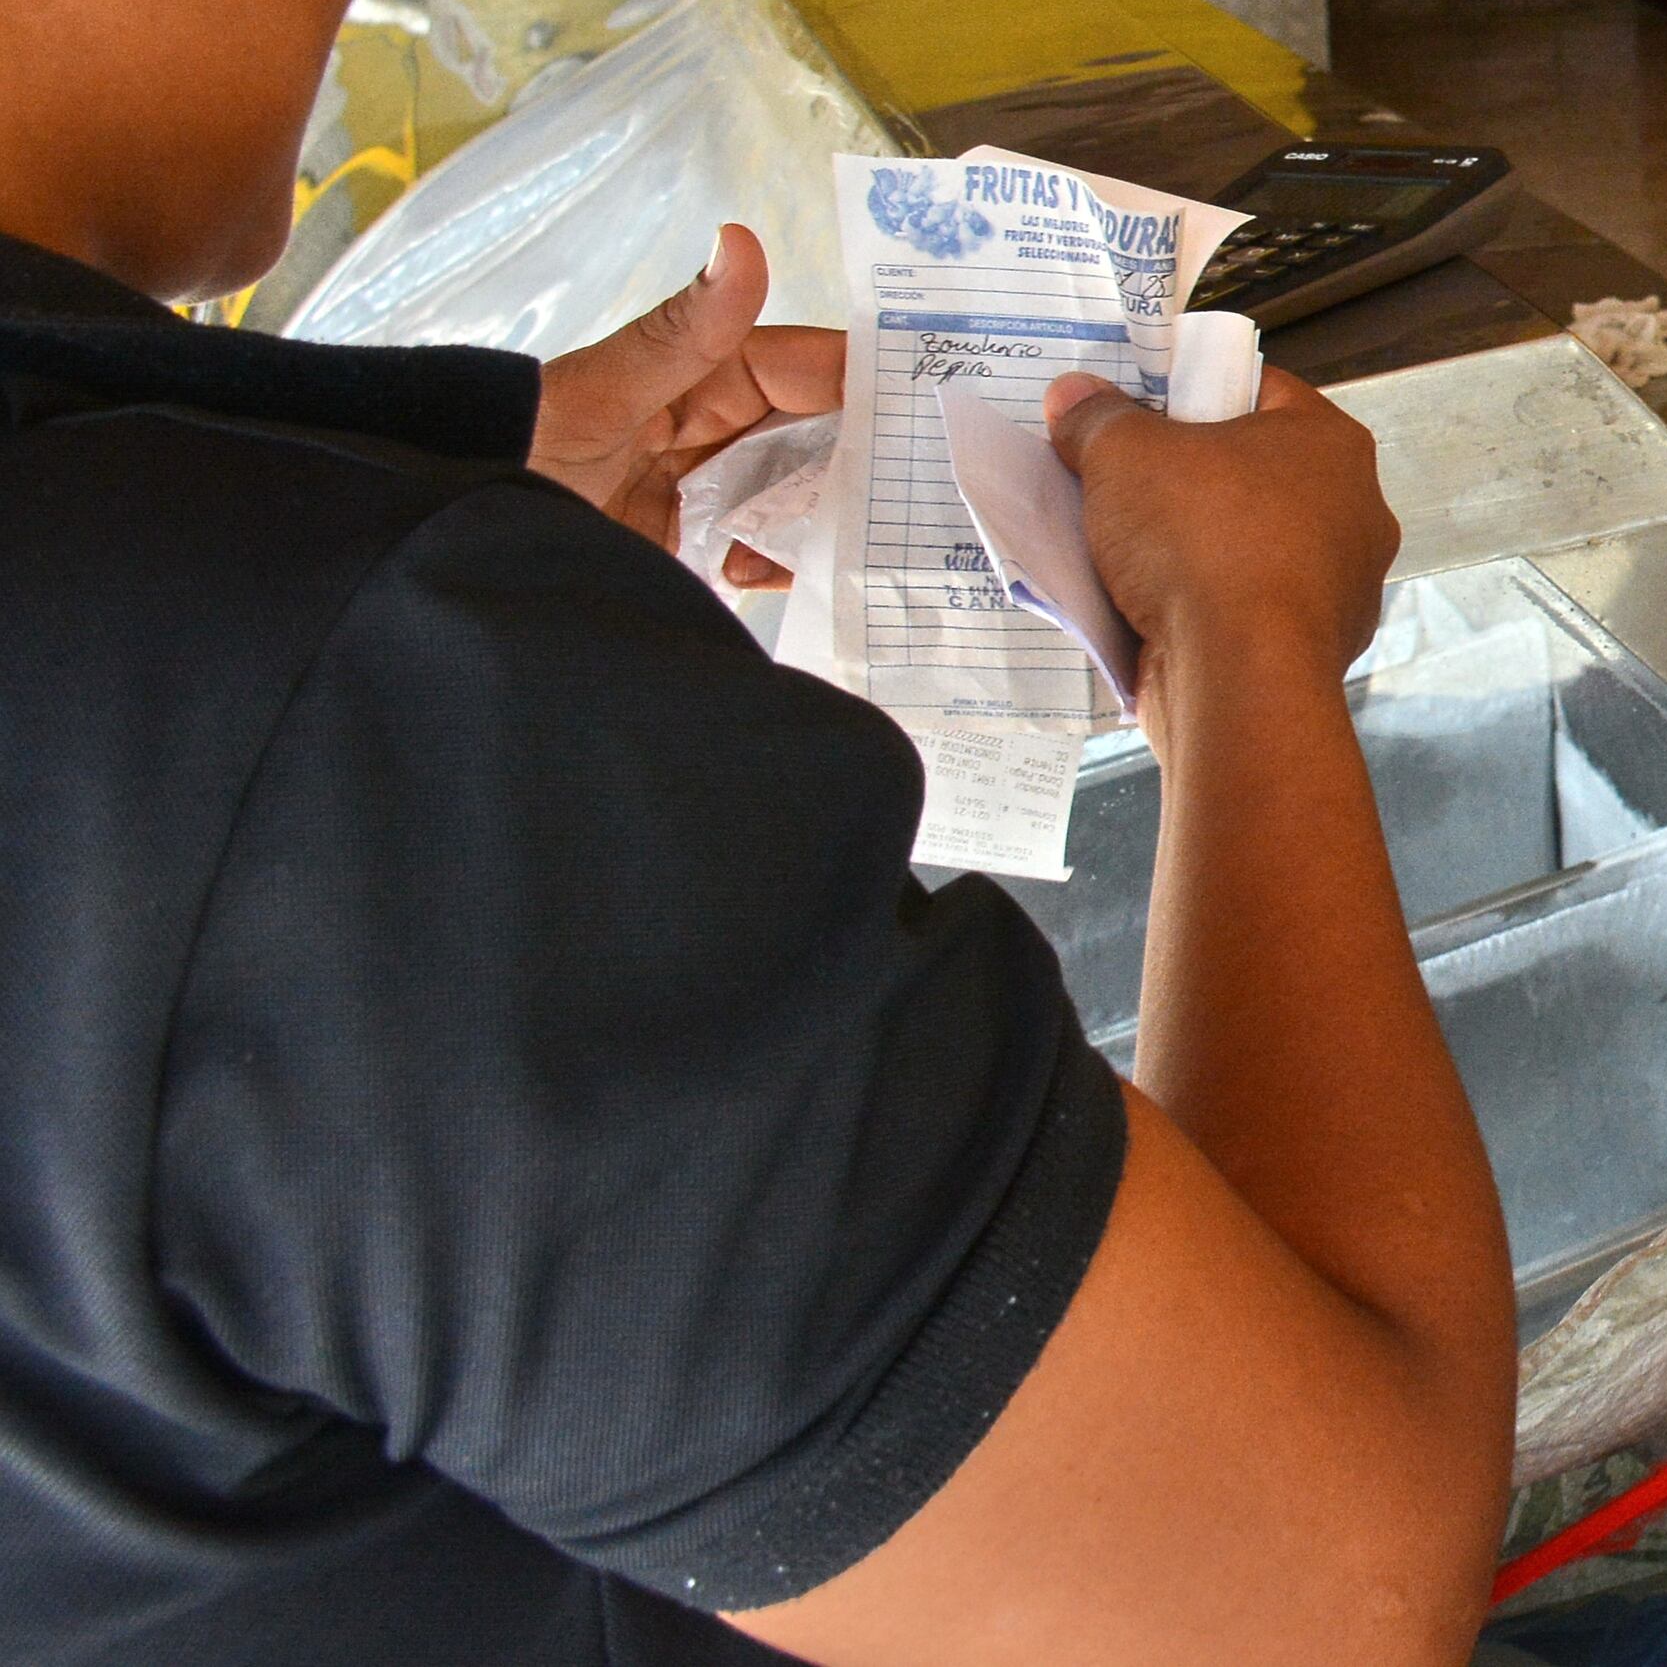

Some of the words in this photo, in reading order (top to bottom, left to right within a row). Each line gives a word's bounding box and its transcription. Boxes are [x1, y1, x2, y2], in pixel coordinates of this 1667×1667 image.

[965, 165, 1060, 209] FRUTAS
[1066, 177, 1079, 212] Y
[1020, 215, 1039, 228] LAS
[1042, 217, 1090, 234] MEJORES
[1003, 229, 1044, 244] FRUTAS
[1047, 233, 1053, 245] Y
[1055, 235, 1109, 253] VERDURAS
[1017, 246, 1102, 265] SELECCIONADAS
